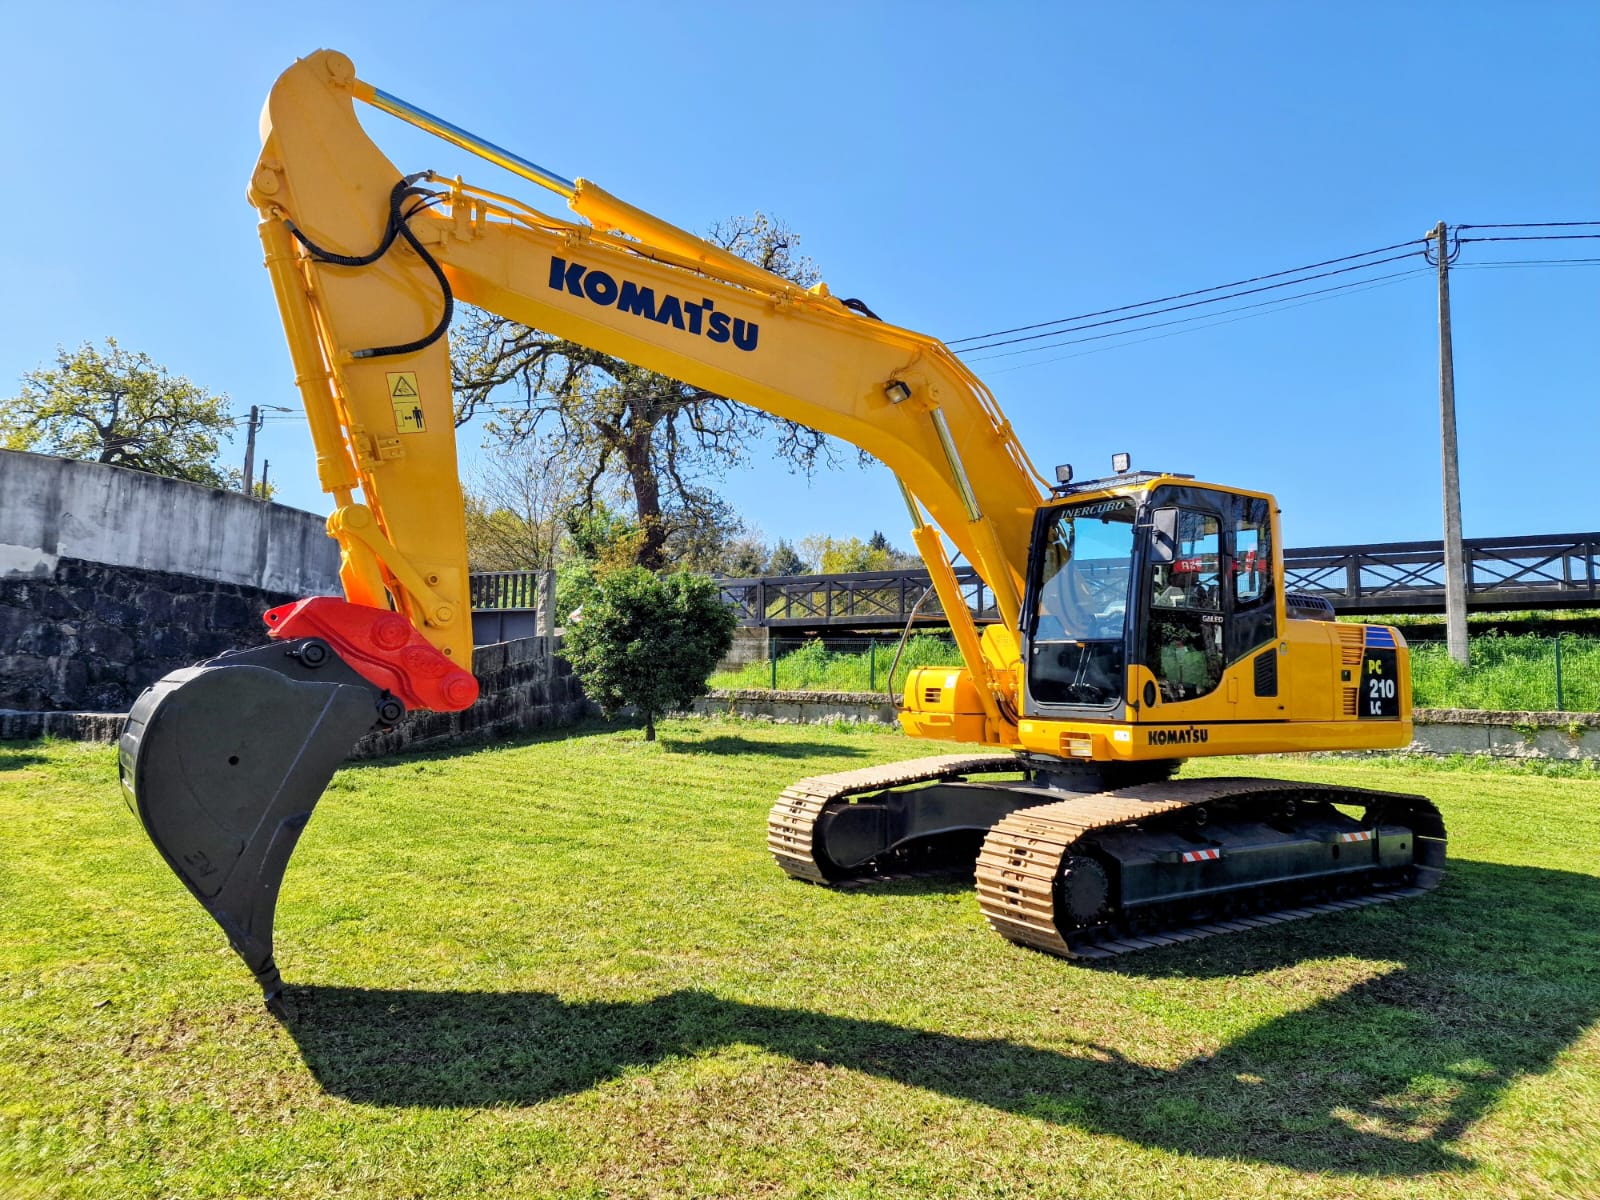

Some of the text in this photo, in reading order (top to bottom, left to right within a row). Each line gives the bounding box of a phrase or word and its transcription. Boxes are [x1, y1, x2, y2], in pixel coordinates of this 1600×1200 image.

[548, 256, 759, 351] KOMATSU
[1368, 659, 1382, 675] PC
[1369, 679, 1395, 698] 210
[1370, 701, 1382, 715] LC
[1148, 725, 1208, 745] KOMATSU
